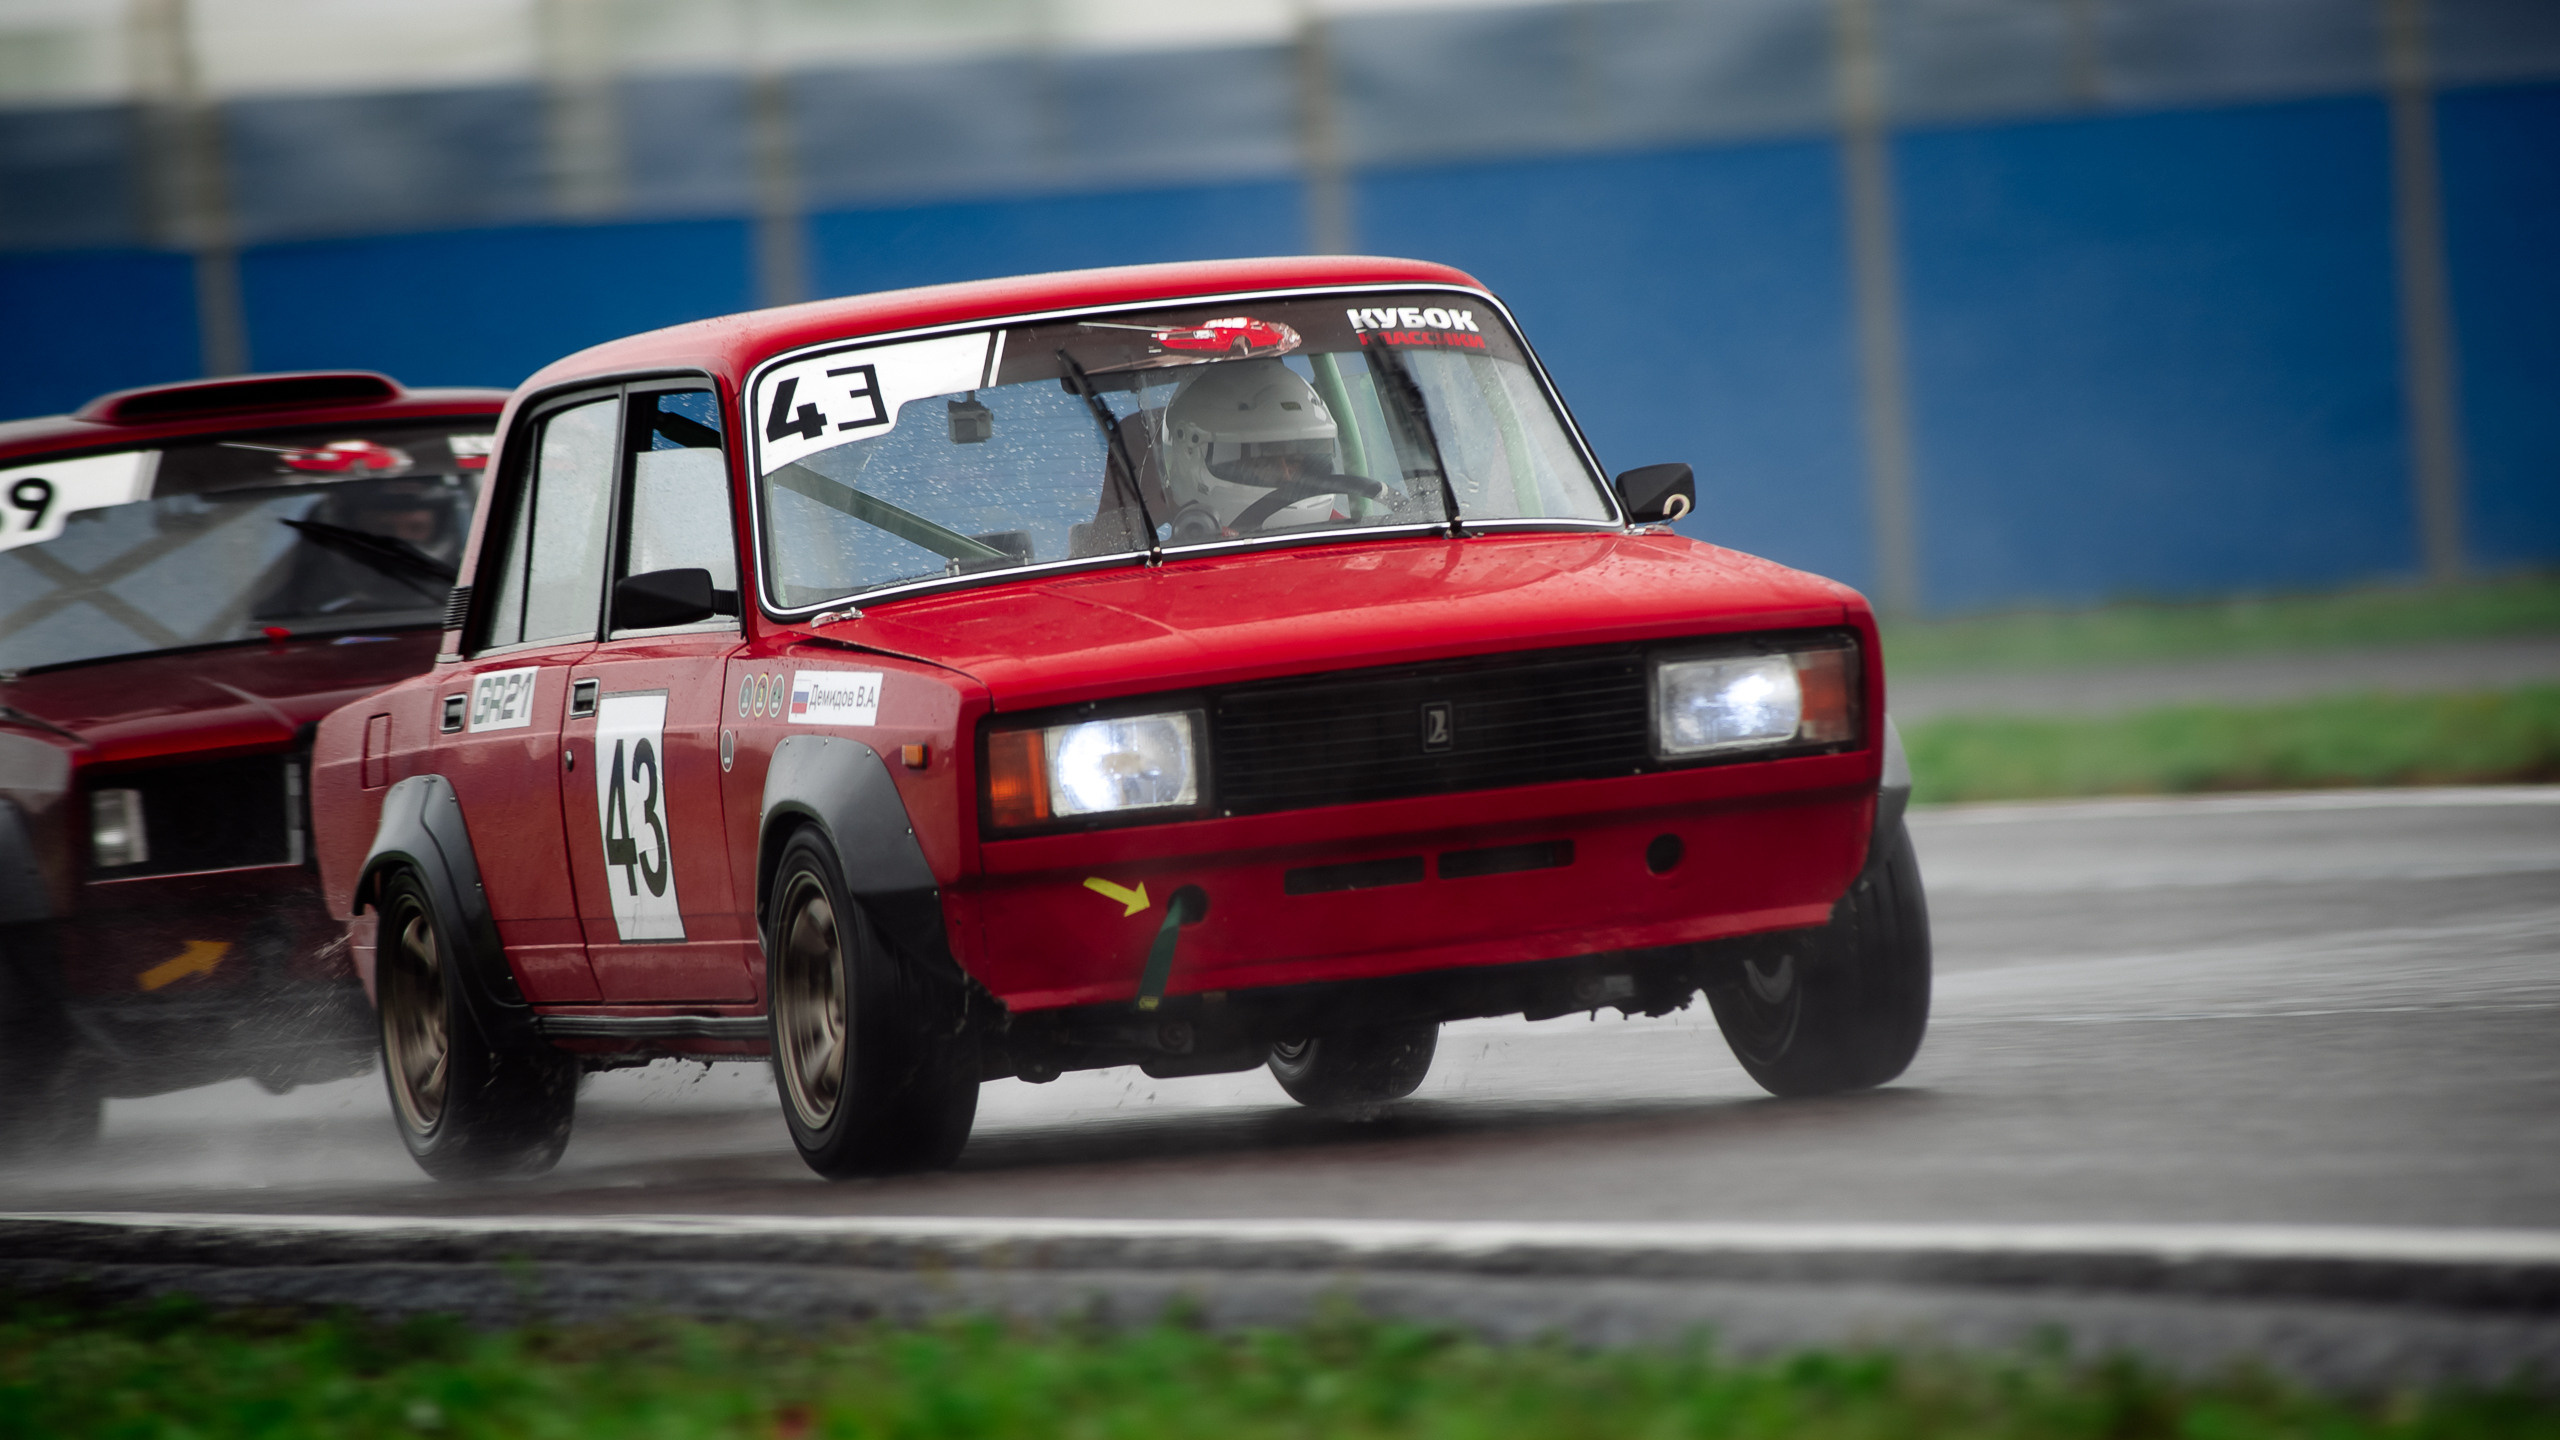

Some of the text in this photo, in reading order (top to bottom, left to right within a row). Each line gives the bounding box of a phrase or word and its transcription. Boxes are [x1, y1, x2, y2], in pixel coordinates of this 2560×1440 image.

[1346, 307, 1480, 332] КУБОК
[766, 363, 889, 443] 43
[0, 477, 54, 532] 9
[809, 684, 854, 711] Демидов
[856, 686, 877, 708] В.А.
[606, 738, 668, 898] 43
